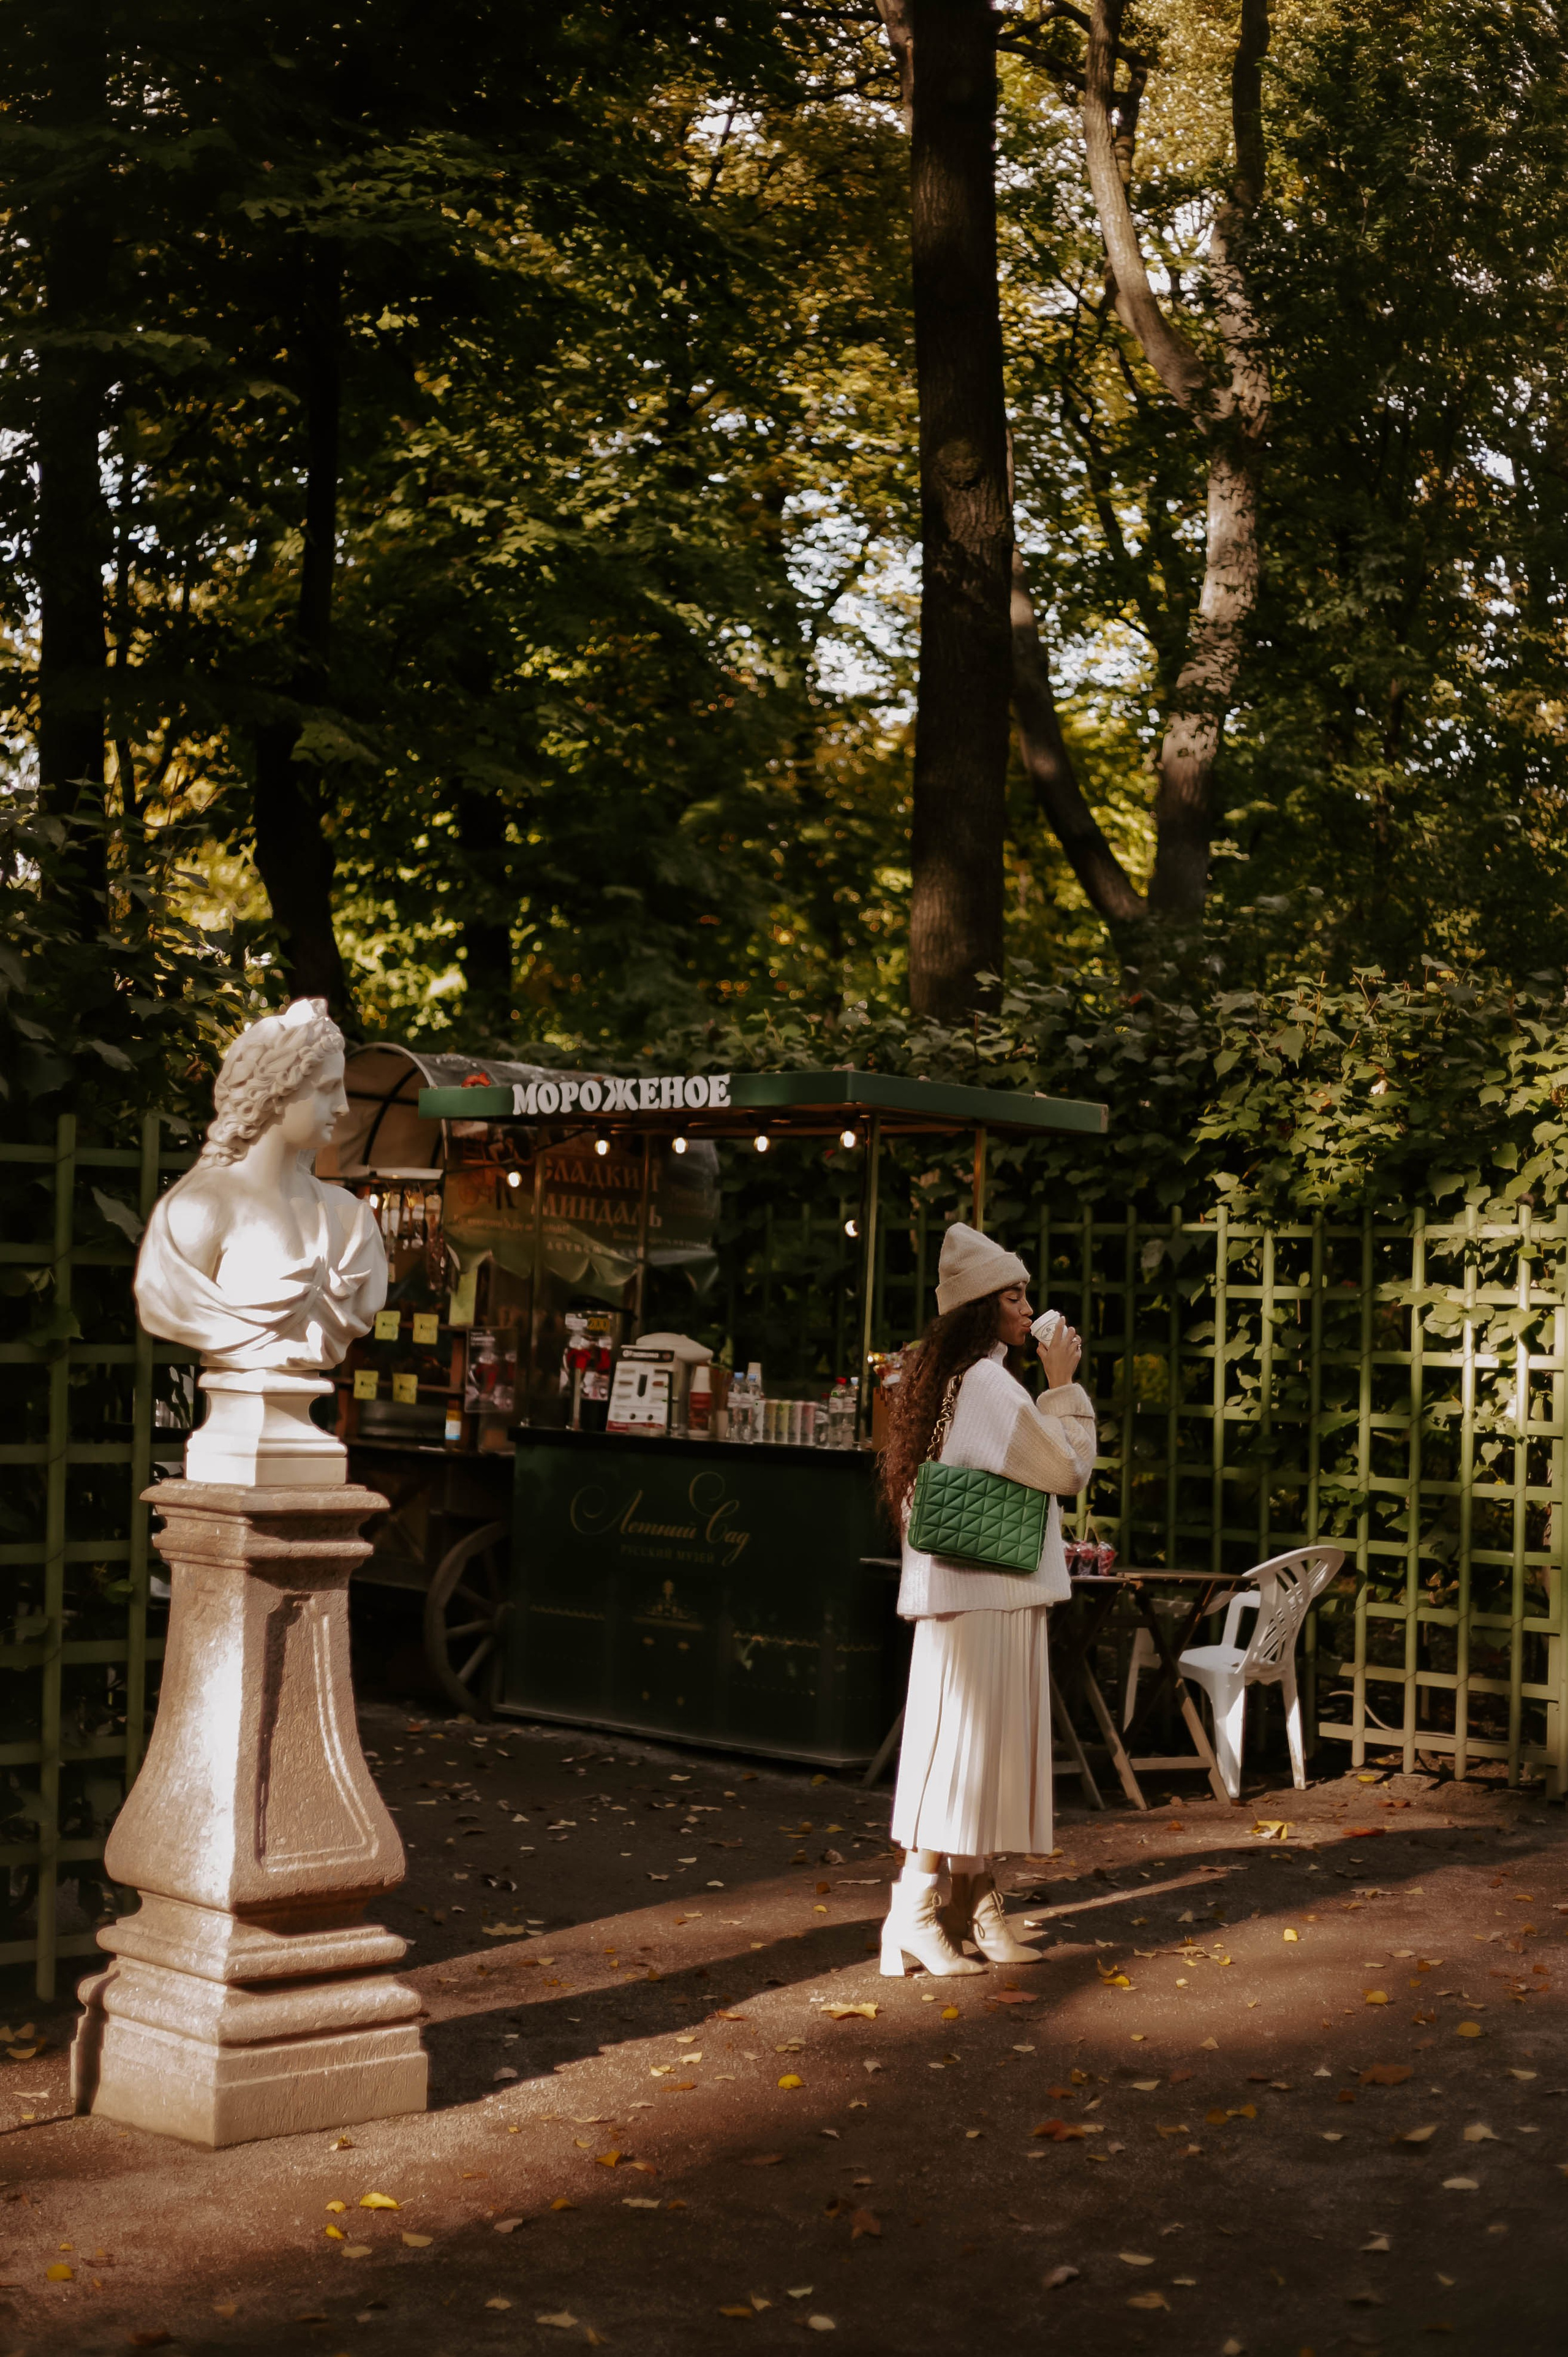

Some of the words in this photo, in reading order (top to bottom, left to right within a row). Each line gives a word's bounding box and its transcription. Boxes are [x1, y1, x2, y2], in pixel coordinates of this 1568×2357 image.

[512, 1073, 731, 1115] МОРОЖЕНОЕ
[569, 1485, 698, 1539] Летний
[688, 1471, 750, 1567] Сад
